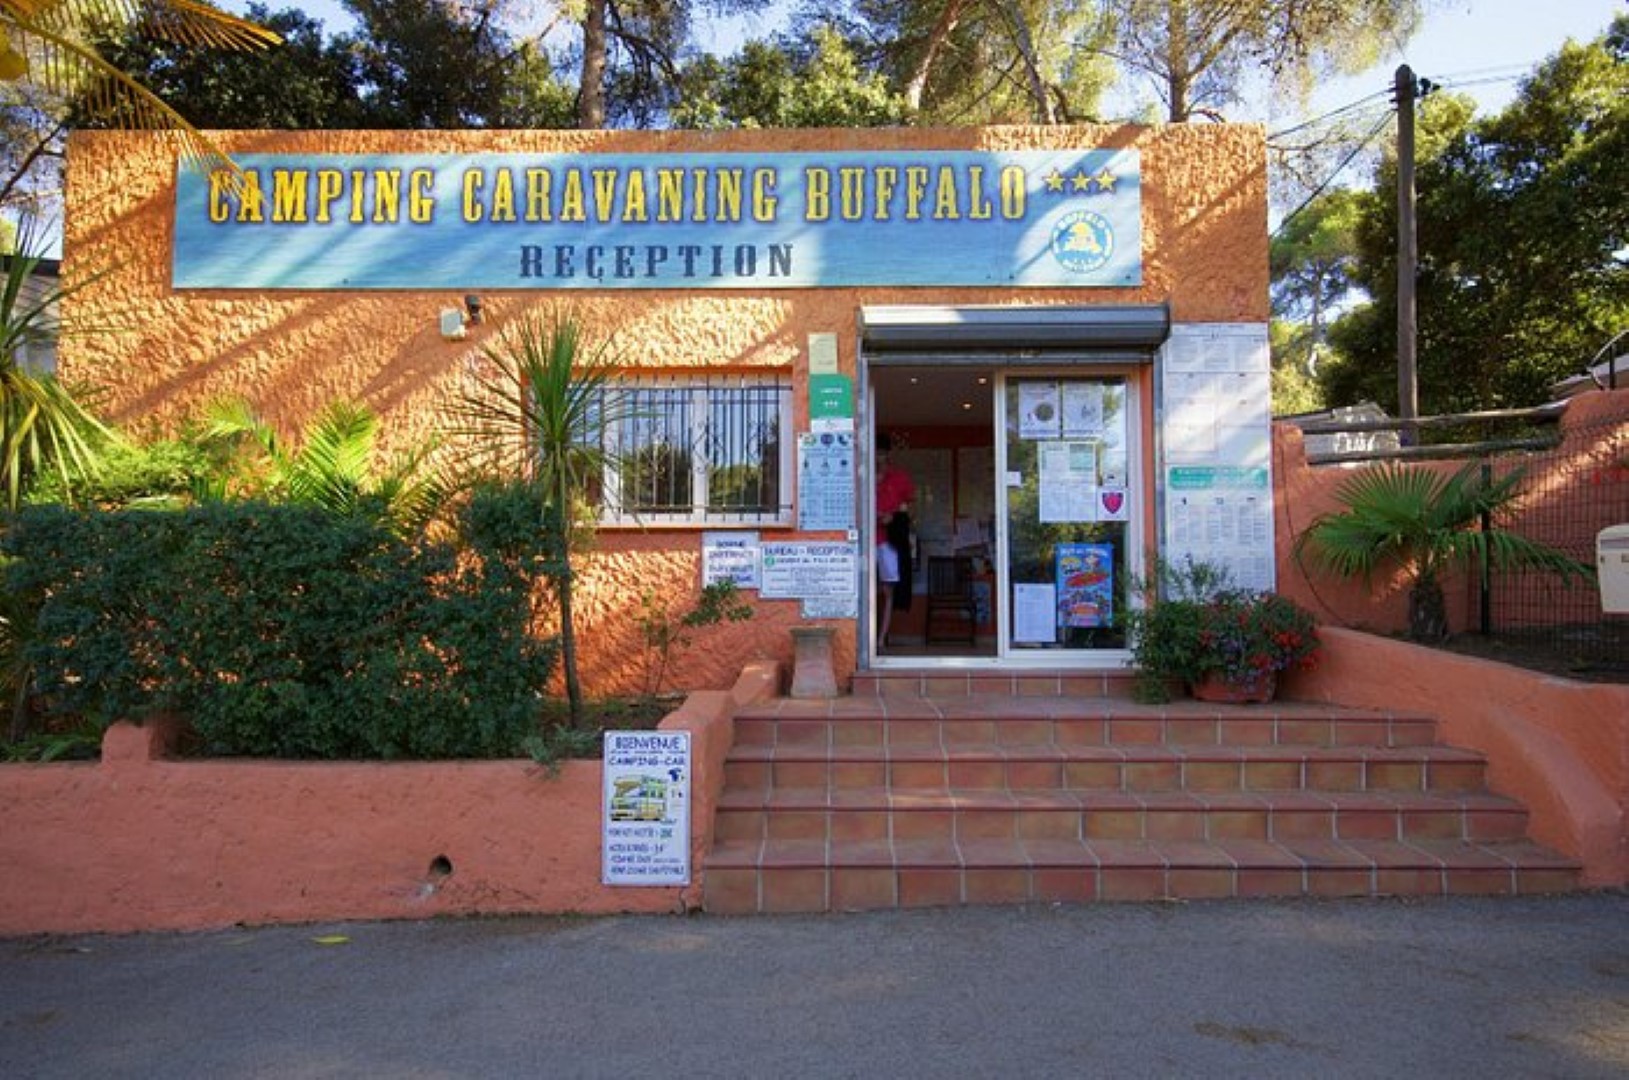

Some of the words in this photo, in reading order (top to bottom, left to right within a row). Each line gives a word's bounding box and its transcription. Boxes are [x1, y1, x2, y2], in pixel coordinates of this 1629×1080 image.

[208, 168, 435, 223] CAMPING
[463, 167, 779, 223] CARAVANING
[805, 165, 1028, 221] BUFFALO
[519, 244, 794, 279] RECEPTION
[615, 736, 680, 749] BIENVENUE
[608, 755, 685, 766] CAMPING-CAR
